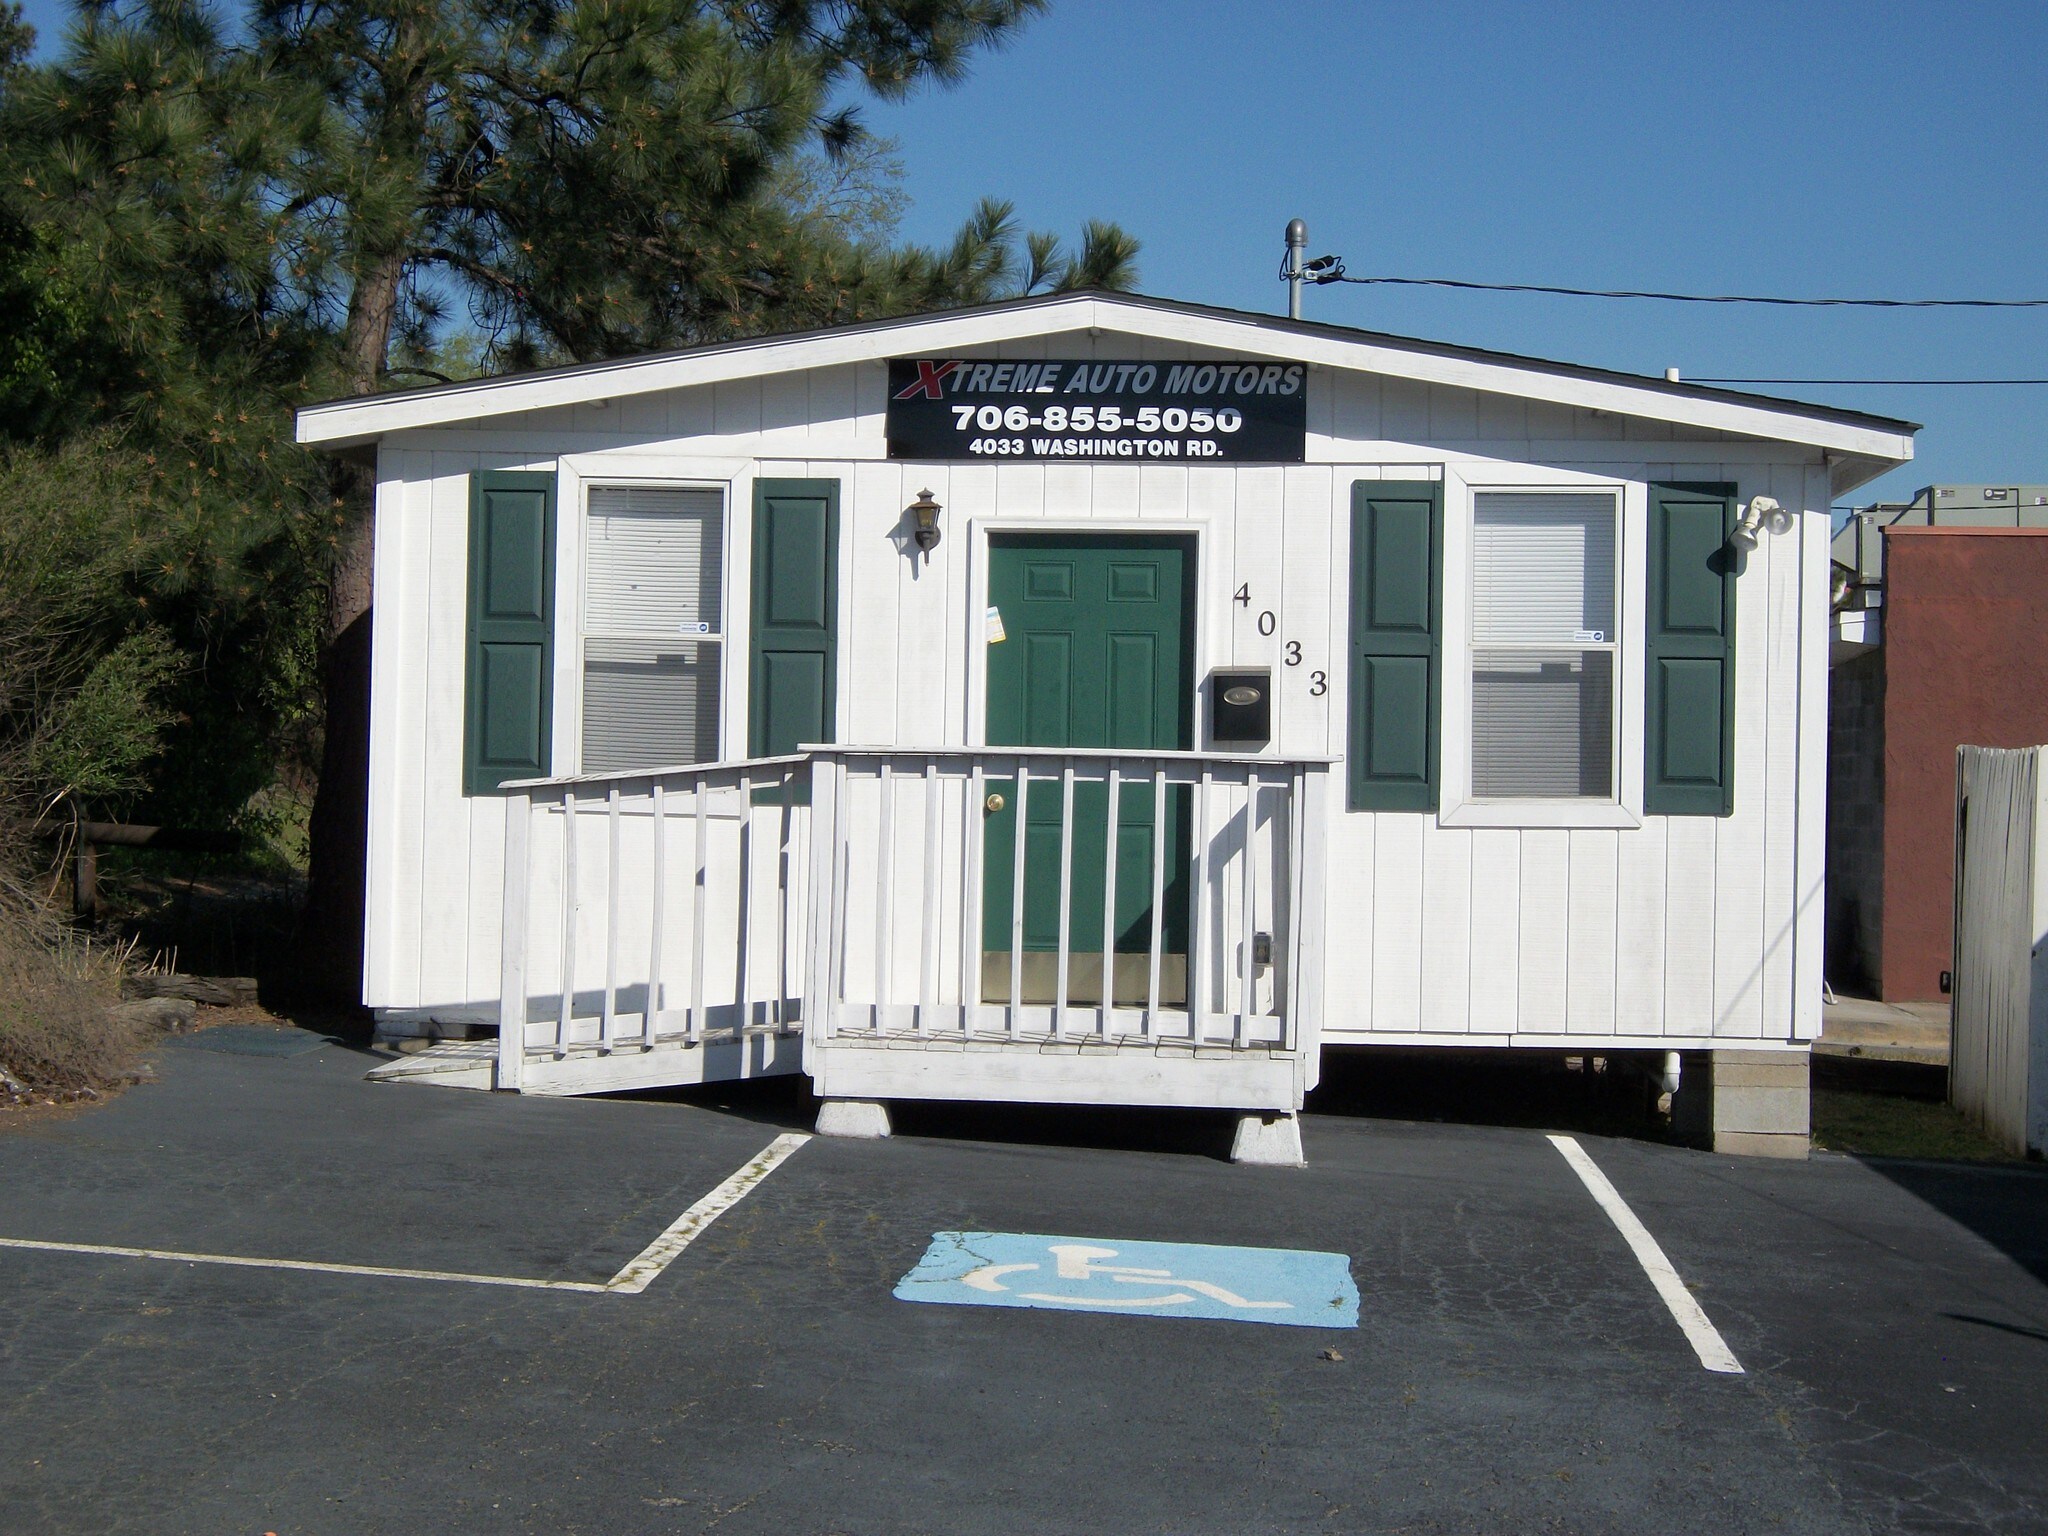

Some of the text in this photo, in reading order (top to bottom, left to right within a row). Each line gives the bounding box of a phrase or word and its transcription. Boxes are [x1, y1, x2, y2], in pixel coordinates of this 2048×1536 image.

[893, 361, 1304, 399] XTREME AUTO MOTORS
[951, 405, 1242, 433] 706-855-5050
[969, 438, 1224, 457] 4033 WASHINGTON RD.
